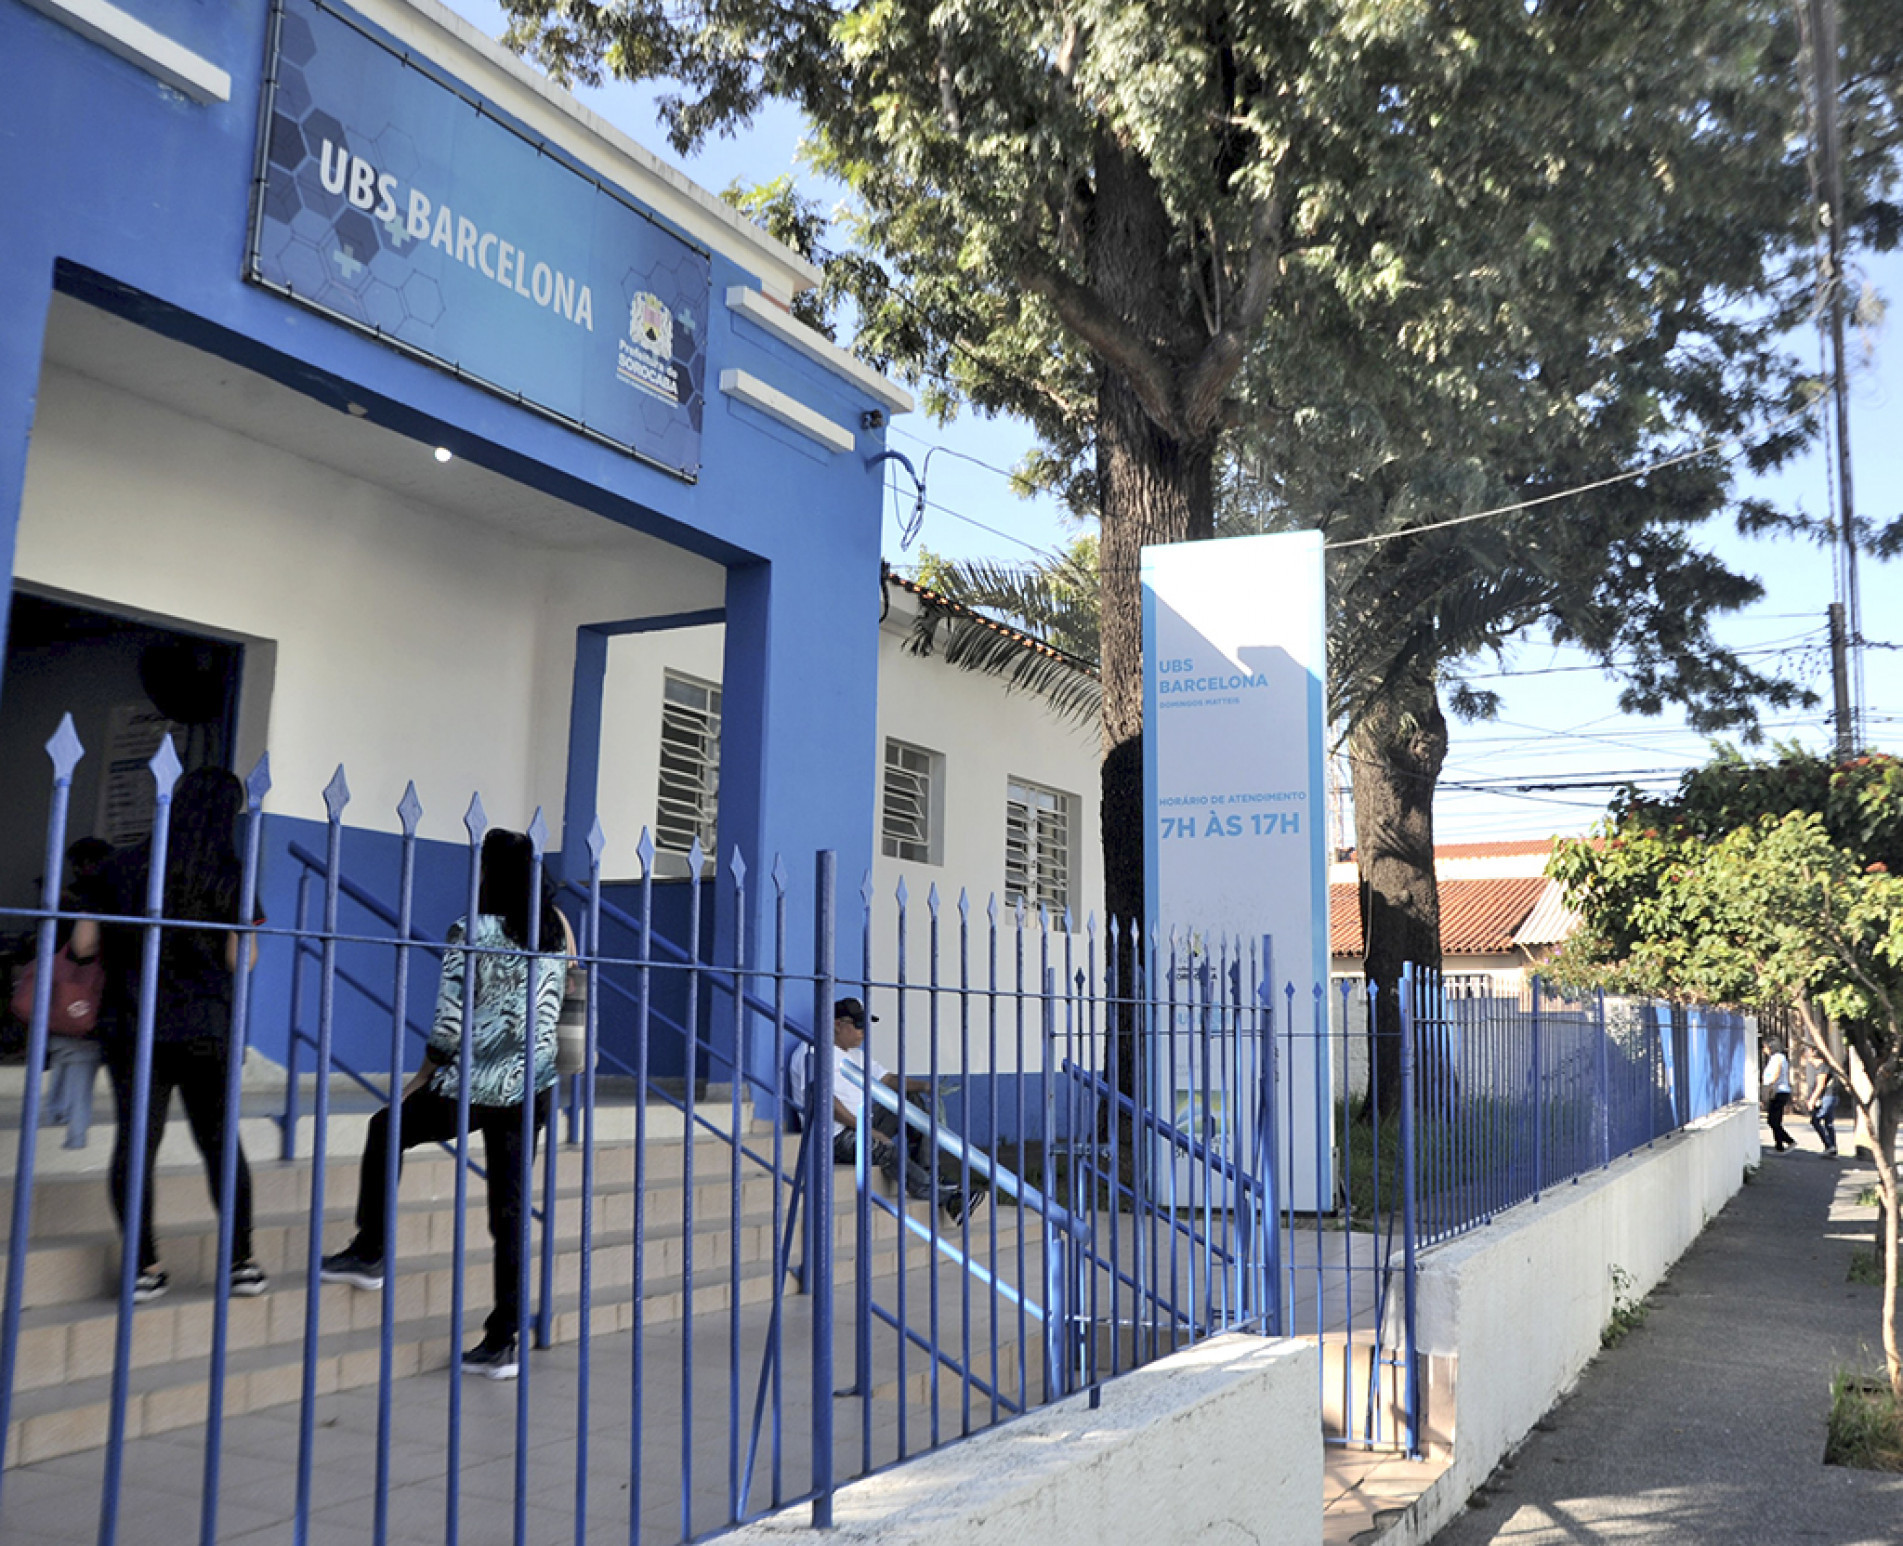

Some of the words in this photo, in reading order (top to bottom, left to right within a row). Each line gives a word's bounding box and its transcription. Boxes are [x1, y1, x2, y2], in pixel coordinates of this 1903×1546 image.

[319, 138, 398, 223] UBS
[407, 188, 593, 332] BARCELONA
[1159, 659, 1194, 674] UBS
[1159, 674, 1268, 694] BARCELONA
[1160, 700, 1203, 709] DOMINGOS
[1159, 793, 1208, 807] HORÁRIO
[1211, 794, 1225, 805] DE
[1228, 791, 1306, 804] ATENDIMENTO
[1161, 817, 1196, 839] 7H
[1204, 810, 1243, 837] ÀS
[1250, 812, 1300, 835] 17H
